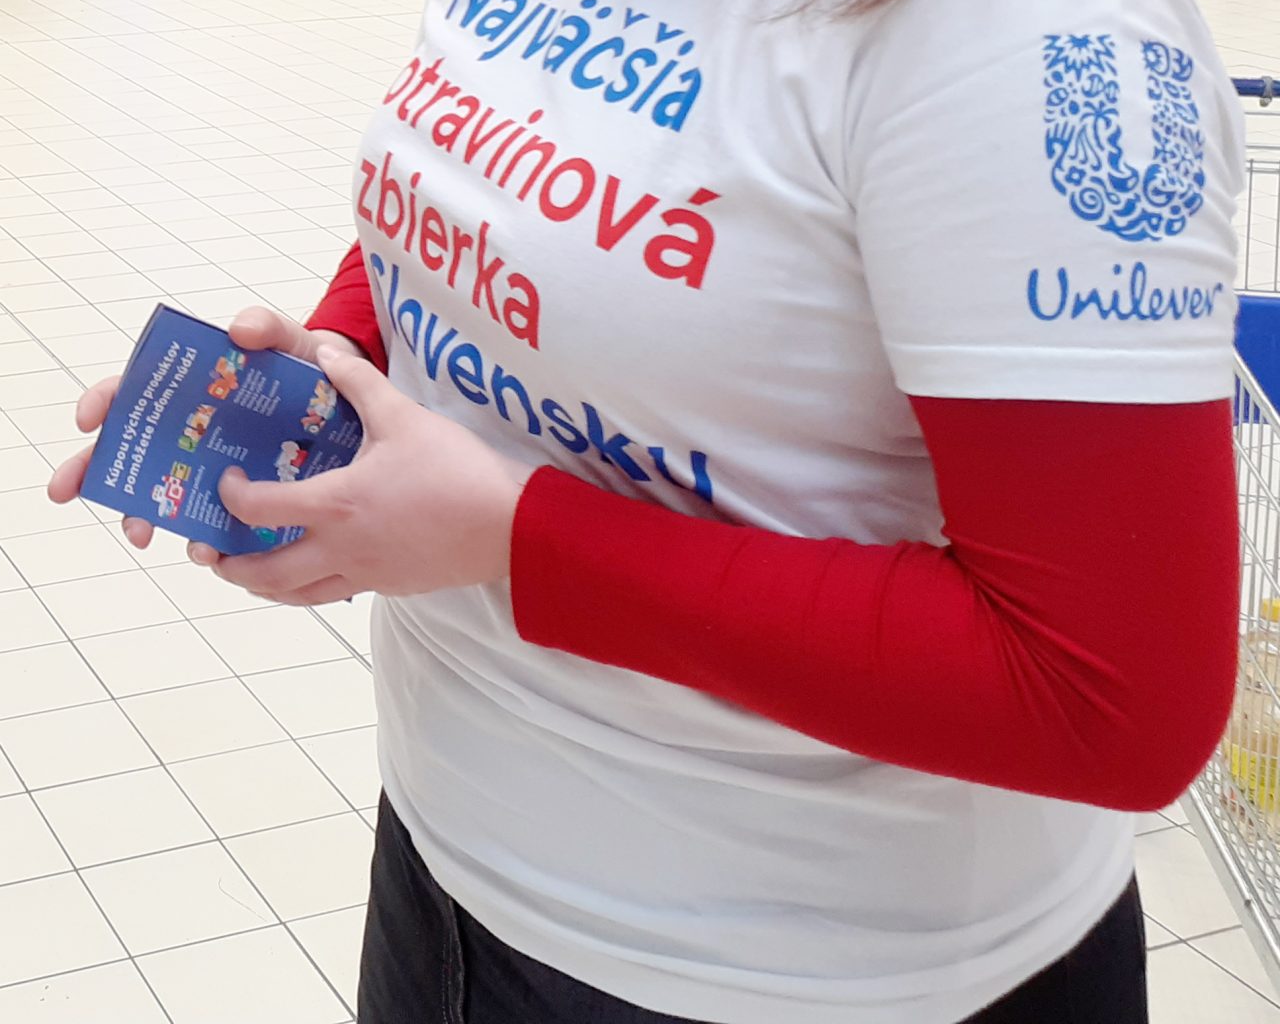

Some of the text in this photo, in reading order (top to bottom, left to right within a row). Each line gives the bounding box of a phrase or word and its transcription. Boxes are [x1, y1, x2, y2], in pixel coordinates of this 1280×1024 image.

[357, 151, 541, 350] zbierka
[1027, 261, 1223, 321] Unilever
[104, 341, 181, 488] Kúpou týchto produktov
[124, 426, 154, 495] pomôžete
[175, 348, 198, 381] núdzi
